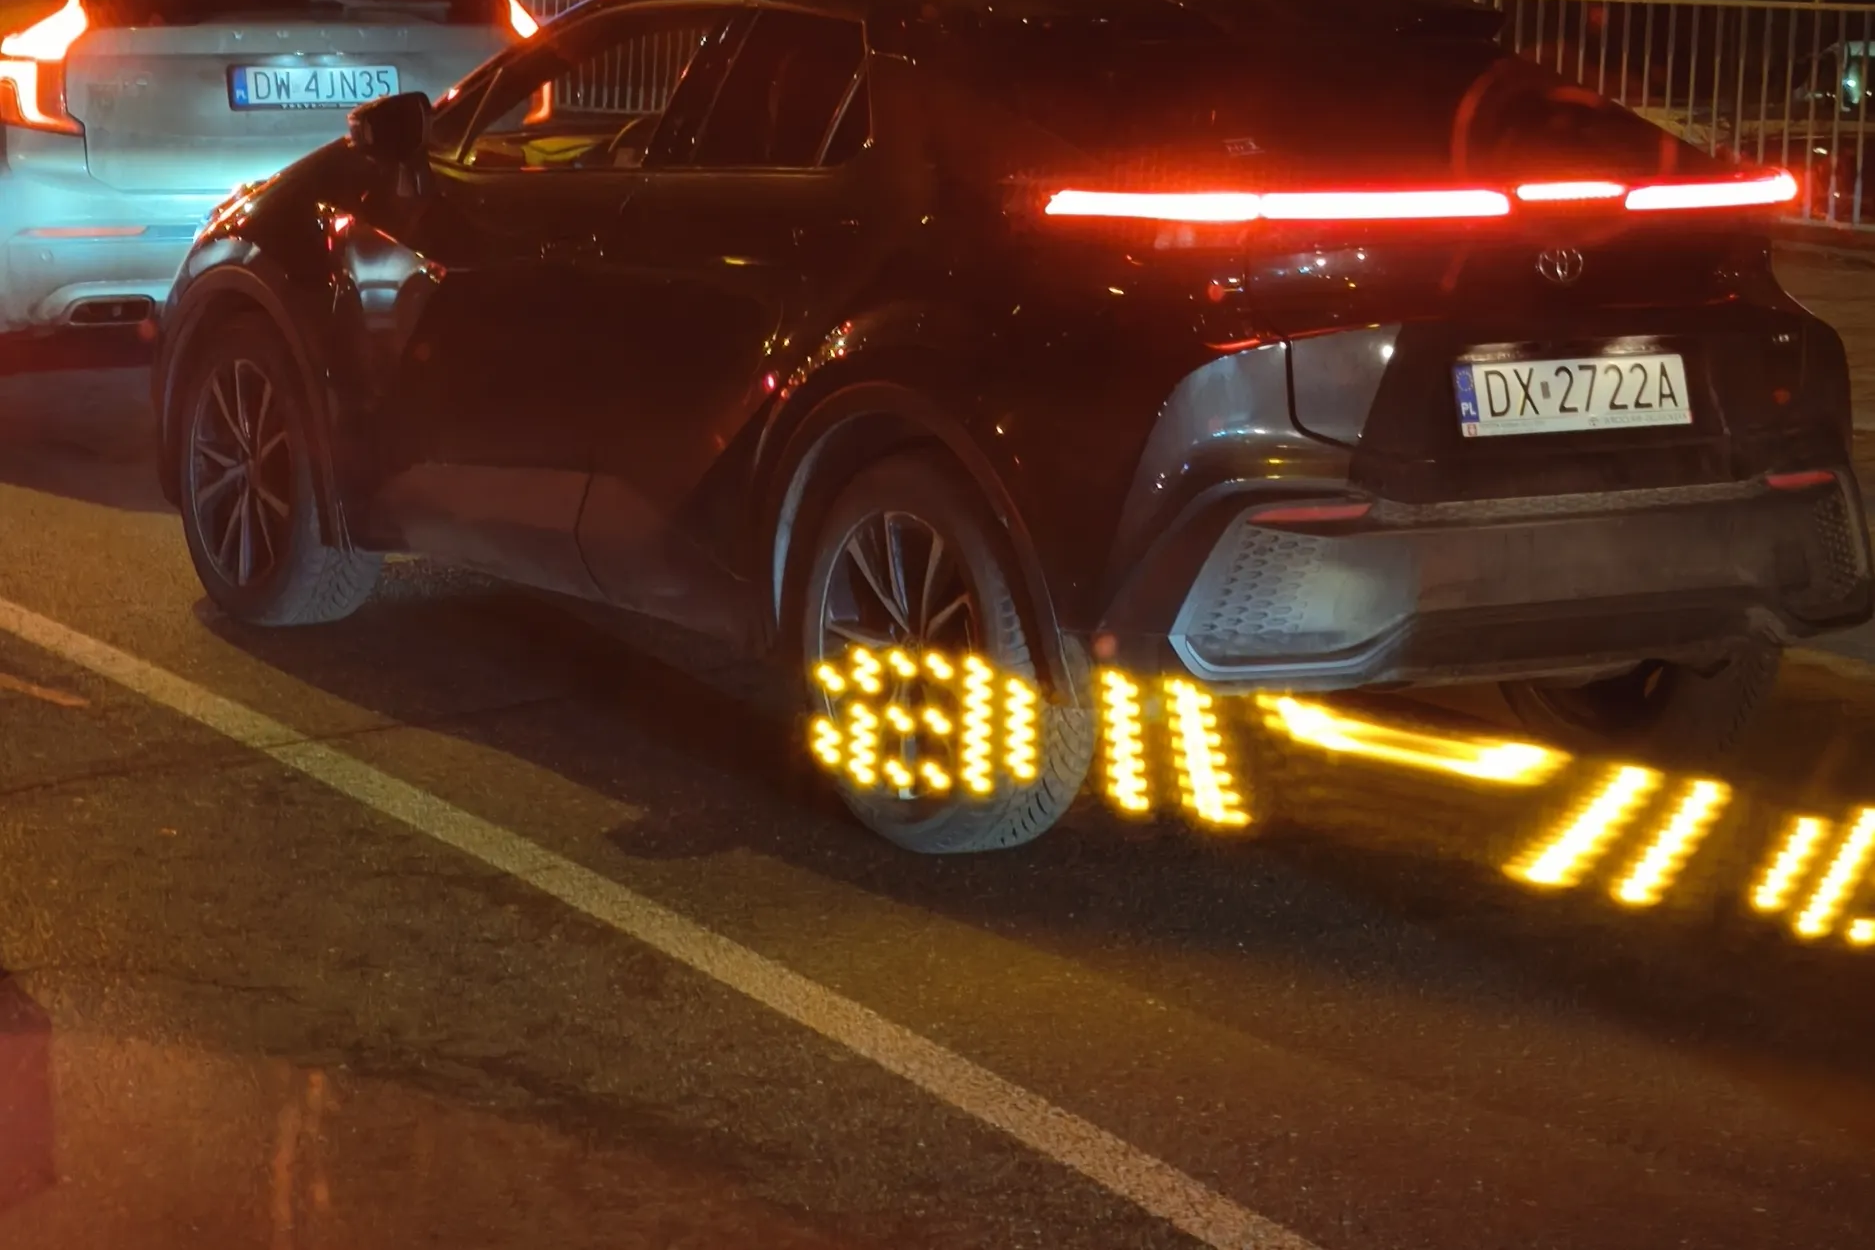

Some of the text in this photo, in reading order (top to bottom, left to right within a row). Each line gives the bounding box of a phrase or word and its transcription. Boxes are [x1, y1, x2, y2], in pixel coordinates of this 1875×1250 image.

[253, 70, 390, 100] DW 4JN35
[1484, 361, 1679, 417] DX 2722A
[1461, 402, 1477, 417] PL
